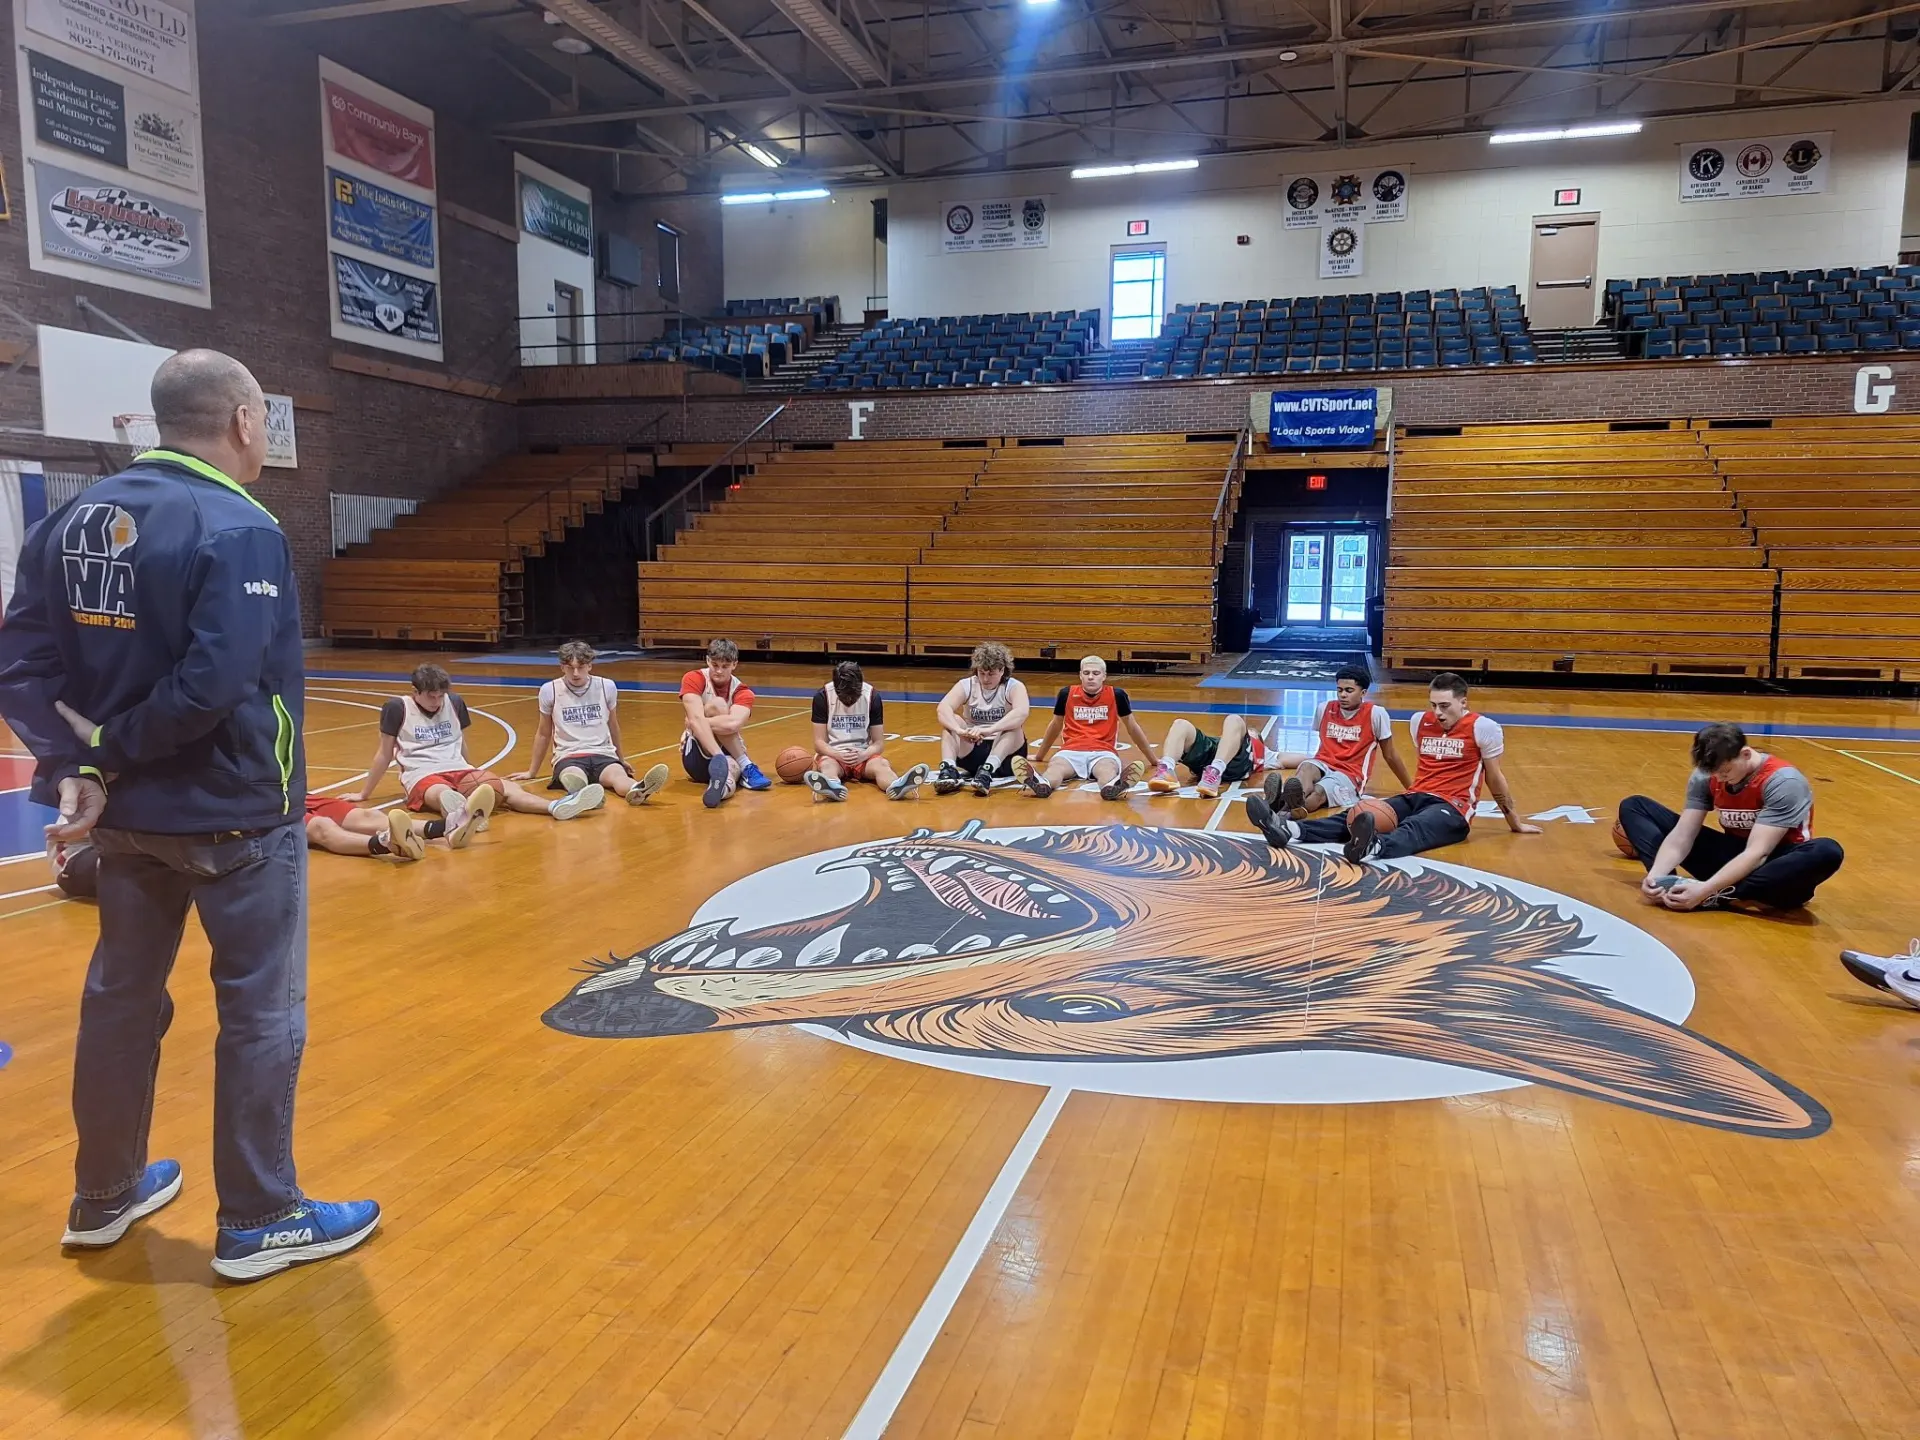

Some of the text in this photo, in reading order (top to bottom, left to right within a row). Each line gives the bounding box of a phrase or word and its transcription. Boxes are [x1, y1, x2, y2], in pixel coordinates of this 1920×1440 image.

[32, 67, 119, 110] Independent Living,
[40, 83, 114, 120] Residential Care,
[37, 98, 117, 132] and Memory Care
[347, 102, 424, 148] Community Bank
[53, 129, 72, 144] (802)
[982, 208, 1012, 216] VERMONT
[1853, 365, 1897, 414] G
[1274, 397, 1373, 414] www.CVTSport.net
[847, 401, 875, 440] F
[1304, 426, 1336, 437] Sports
[1310, 476, 1326, 489] EXIT
[562, 705, 602, 716] HARTFORD
[562, 711, 603, 721] BASKETBALL
[414, 722, 452, 733] HARTFORD
[1421, 737, 1465, 749] HARTFORD
[1420, 745, 1464, 757] BASKETBALL
[1720, 811, 1759, 821] RTFOR
[260, 1227, 313, 1250] HOKA
